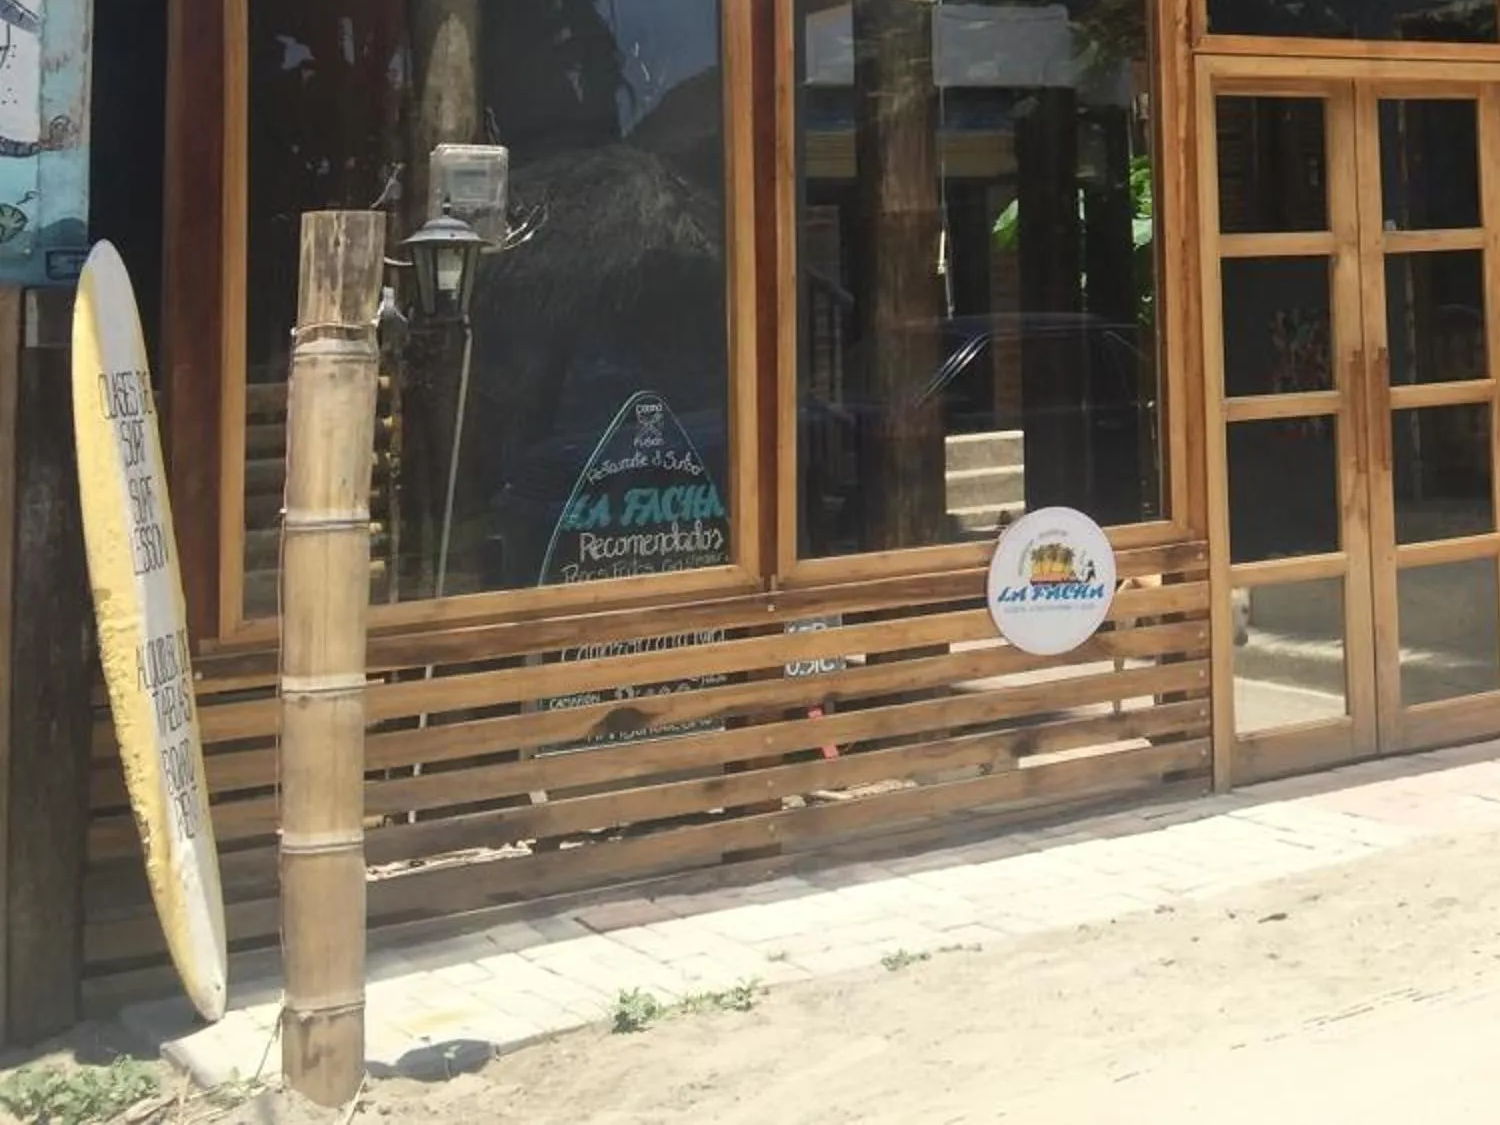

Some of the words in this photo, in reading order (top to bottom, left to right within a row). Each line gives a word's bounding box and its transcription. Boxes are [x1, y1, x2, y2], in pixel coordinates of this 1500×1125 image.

[120, 418, 145, 467] SURF
[128, 475, 152, 525] SURF
[997, 586, 1028, 603] LA
